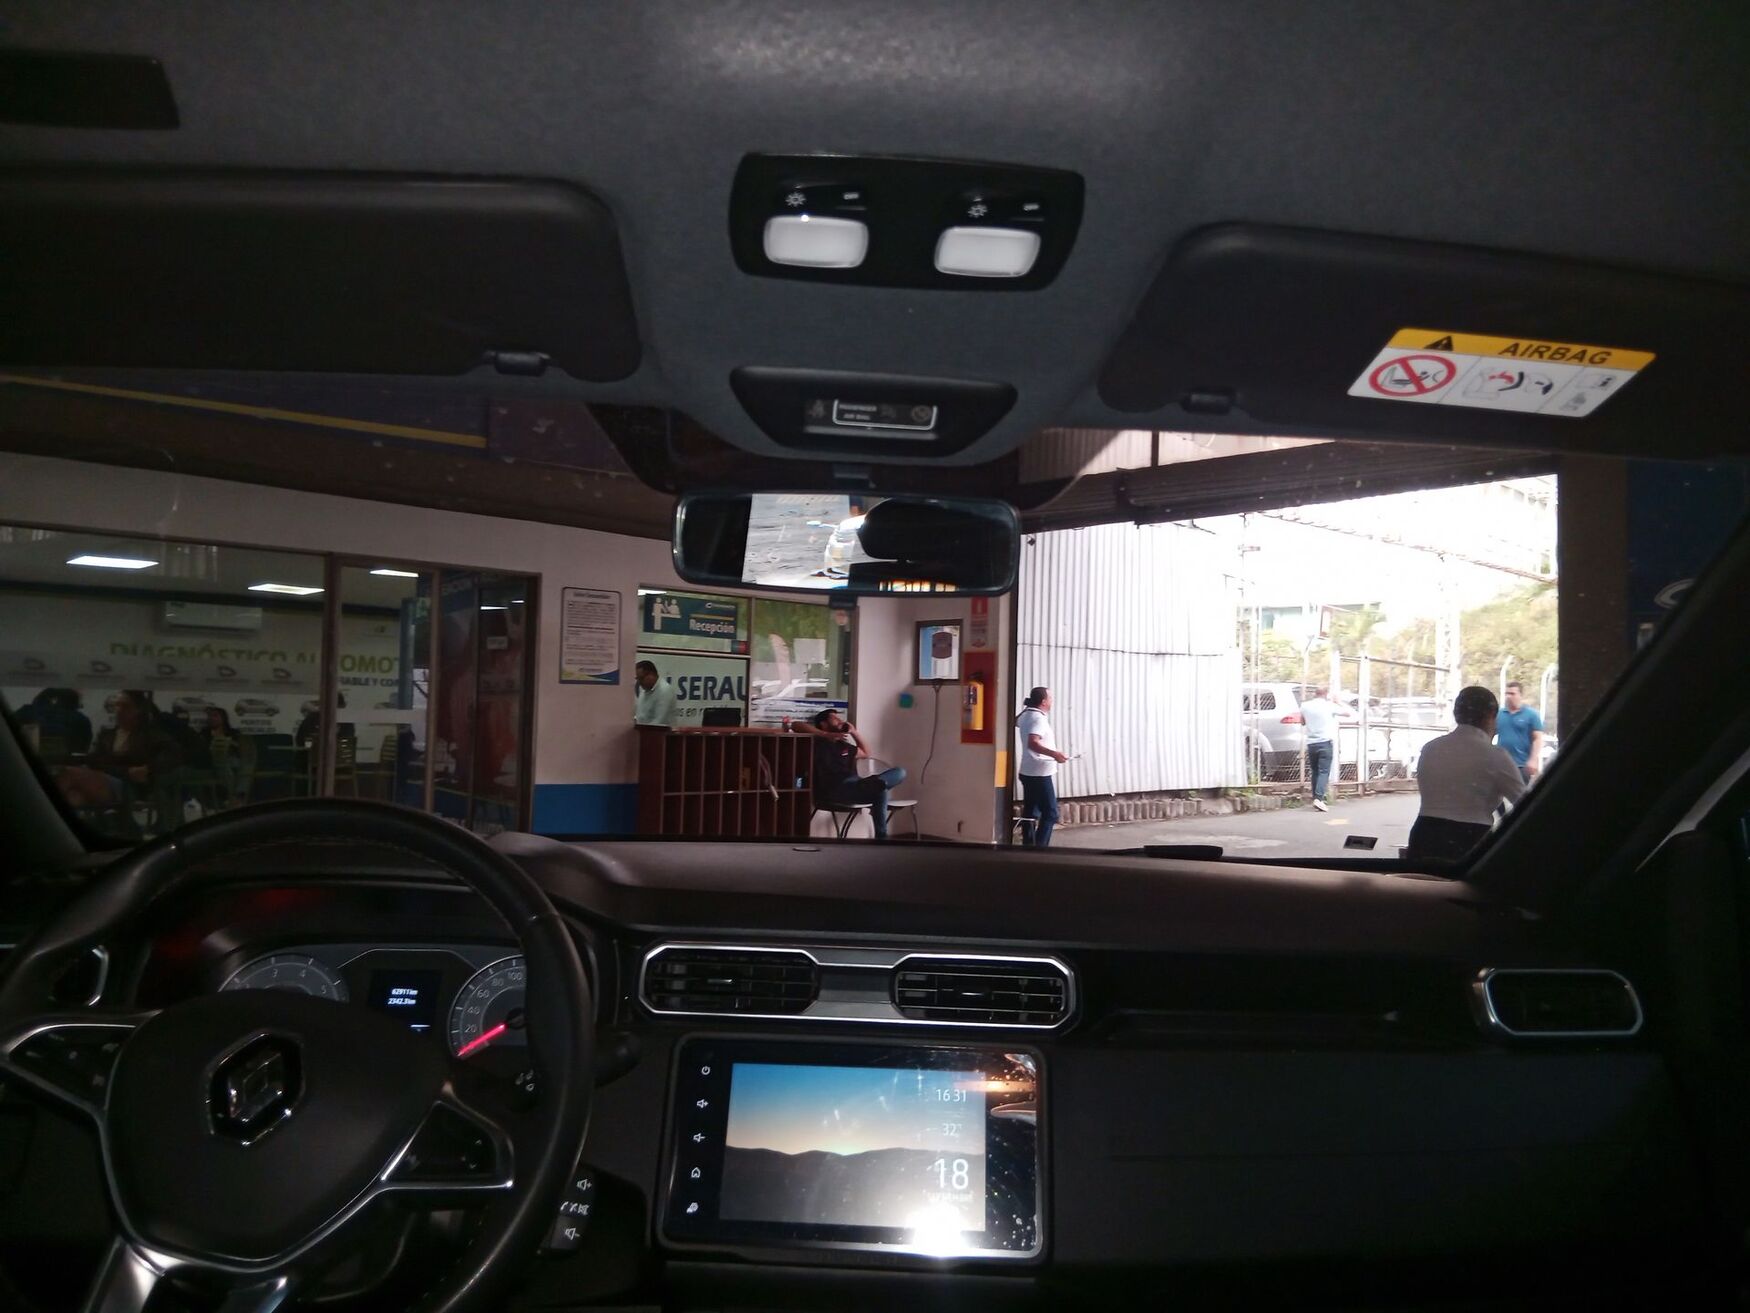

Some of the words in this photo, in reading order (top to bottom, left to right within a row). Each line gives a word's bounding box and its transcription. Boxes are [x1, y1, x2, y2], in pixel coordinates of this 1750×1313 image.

[1498, 341, 1612, 365] AIRBAG
[688, 618, 736, 636] Recepción
[271, 968, 279, 978] 3
[491, 978, 505, 988] 80
[477, 989, 490, 999] 60
[467, 1007, 481, 1016] 40
[464, 1024, 477, 1034] 20
[934, 1158, 970, 1190] 18
